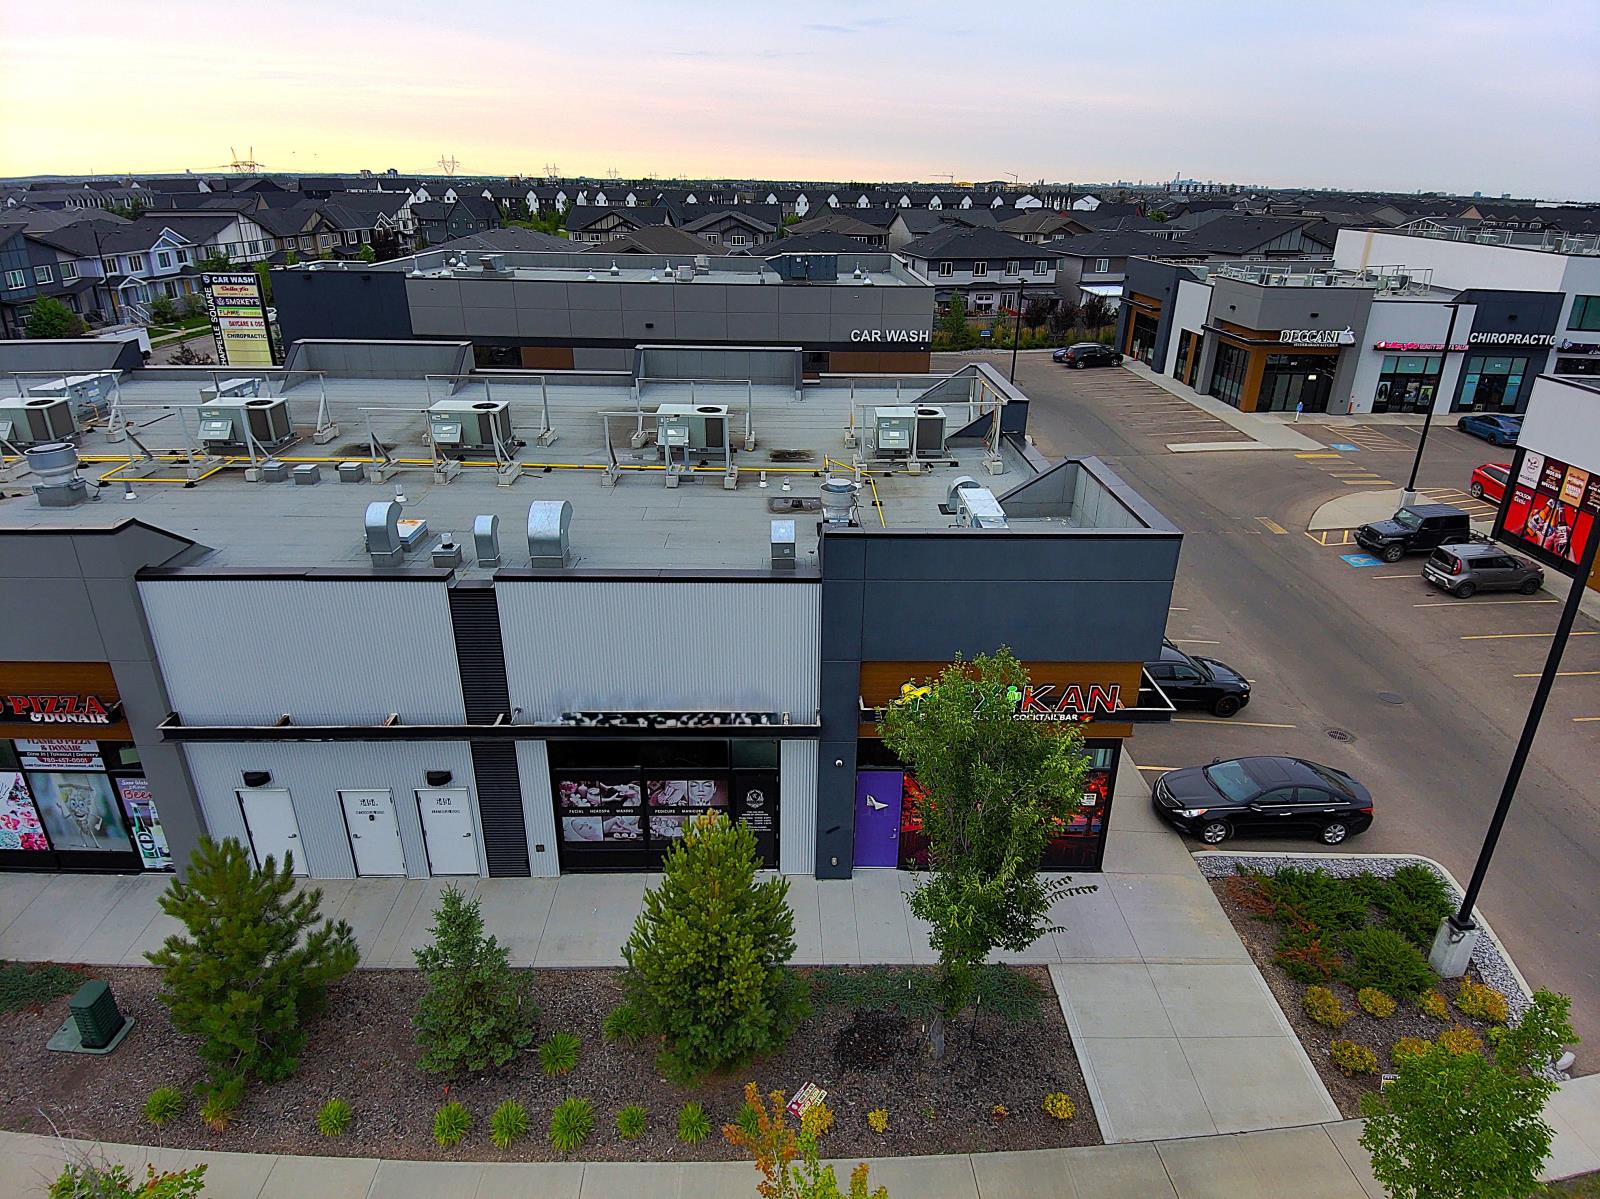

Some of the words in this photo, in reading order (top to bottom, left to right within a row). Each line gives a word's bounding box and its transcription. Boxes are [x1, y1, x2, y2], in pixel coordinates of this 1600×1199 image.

[212, 276, 229, 284] CAR
[229, 276, 254, 284] WASH
[204, 287, 218, 323] SQUARE
[850, 329, 882, 342] CAR
[885, 329, 929, 342] WASH
[1469, 332, 1557, 346] CHIROPRACTIC
[7, 695, 108, 715] PIZZA
[1013, 713, 1059, 721] COCKTAIL
[1059, 713, 1078, 721] BAR
